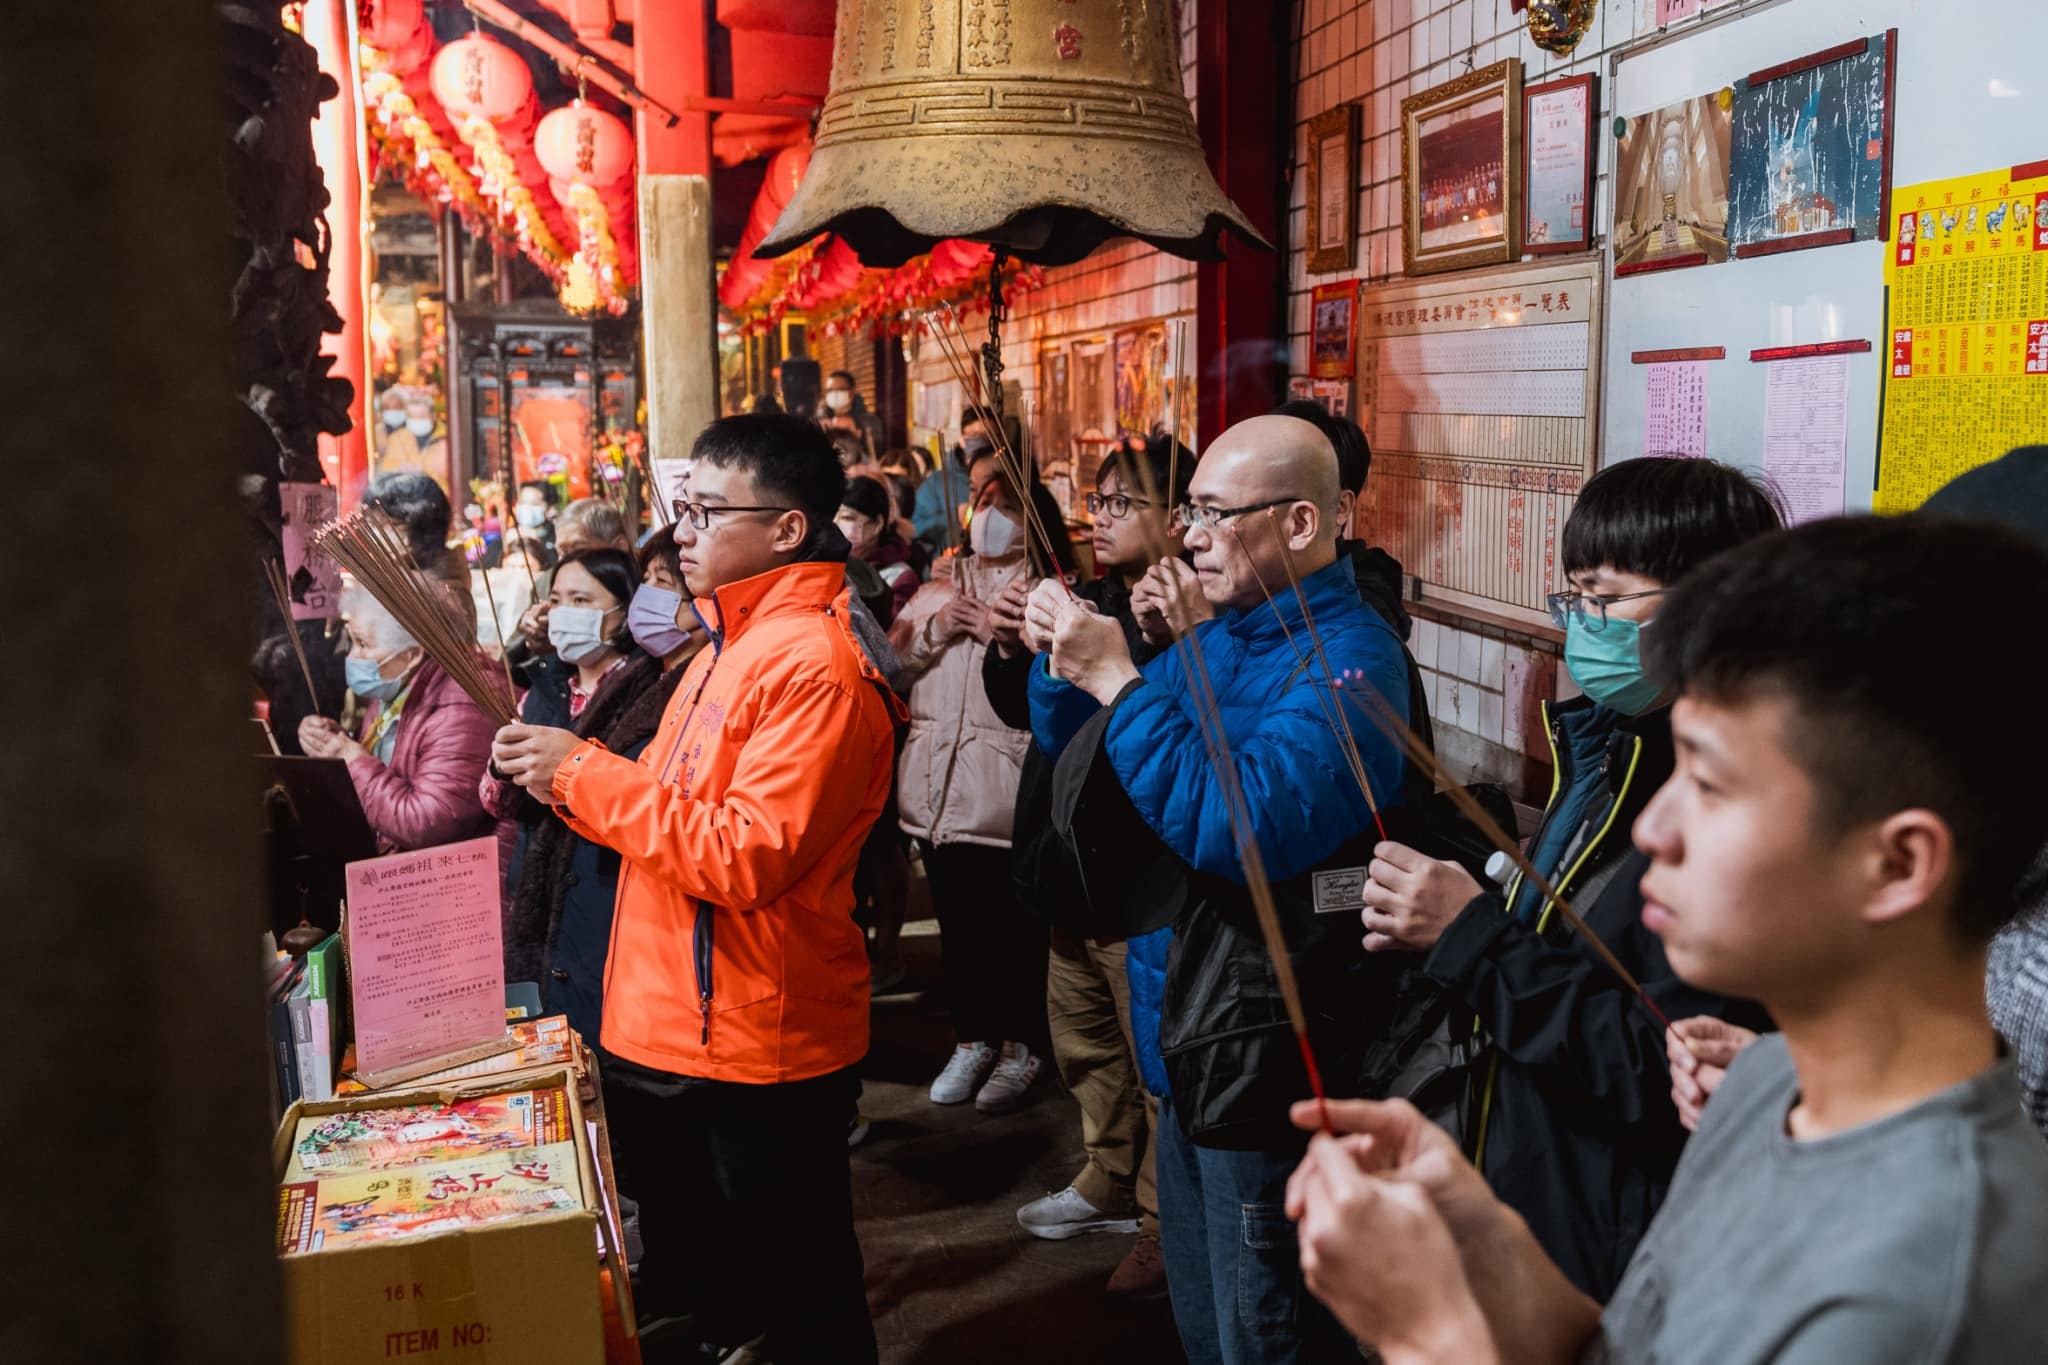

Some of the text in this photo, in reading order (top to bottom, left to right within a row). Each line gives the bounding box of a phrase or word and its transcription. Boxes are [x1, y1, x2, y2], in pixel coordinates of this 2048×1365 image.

[1055, 24, 1083, 59] 宮
[1990, 237, 2001, 249] 羊
[1524, 291, 1571, 313] 一覽表
[384, 1282, 425, 1301] 16 K
[386, 1322, 492, 1358] ITEM NO:
